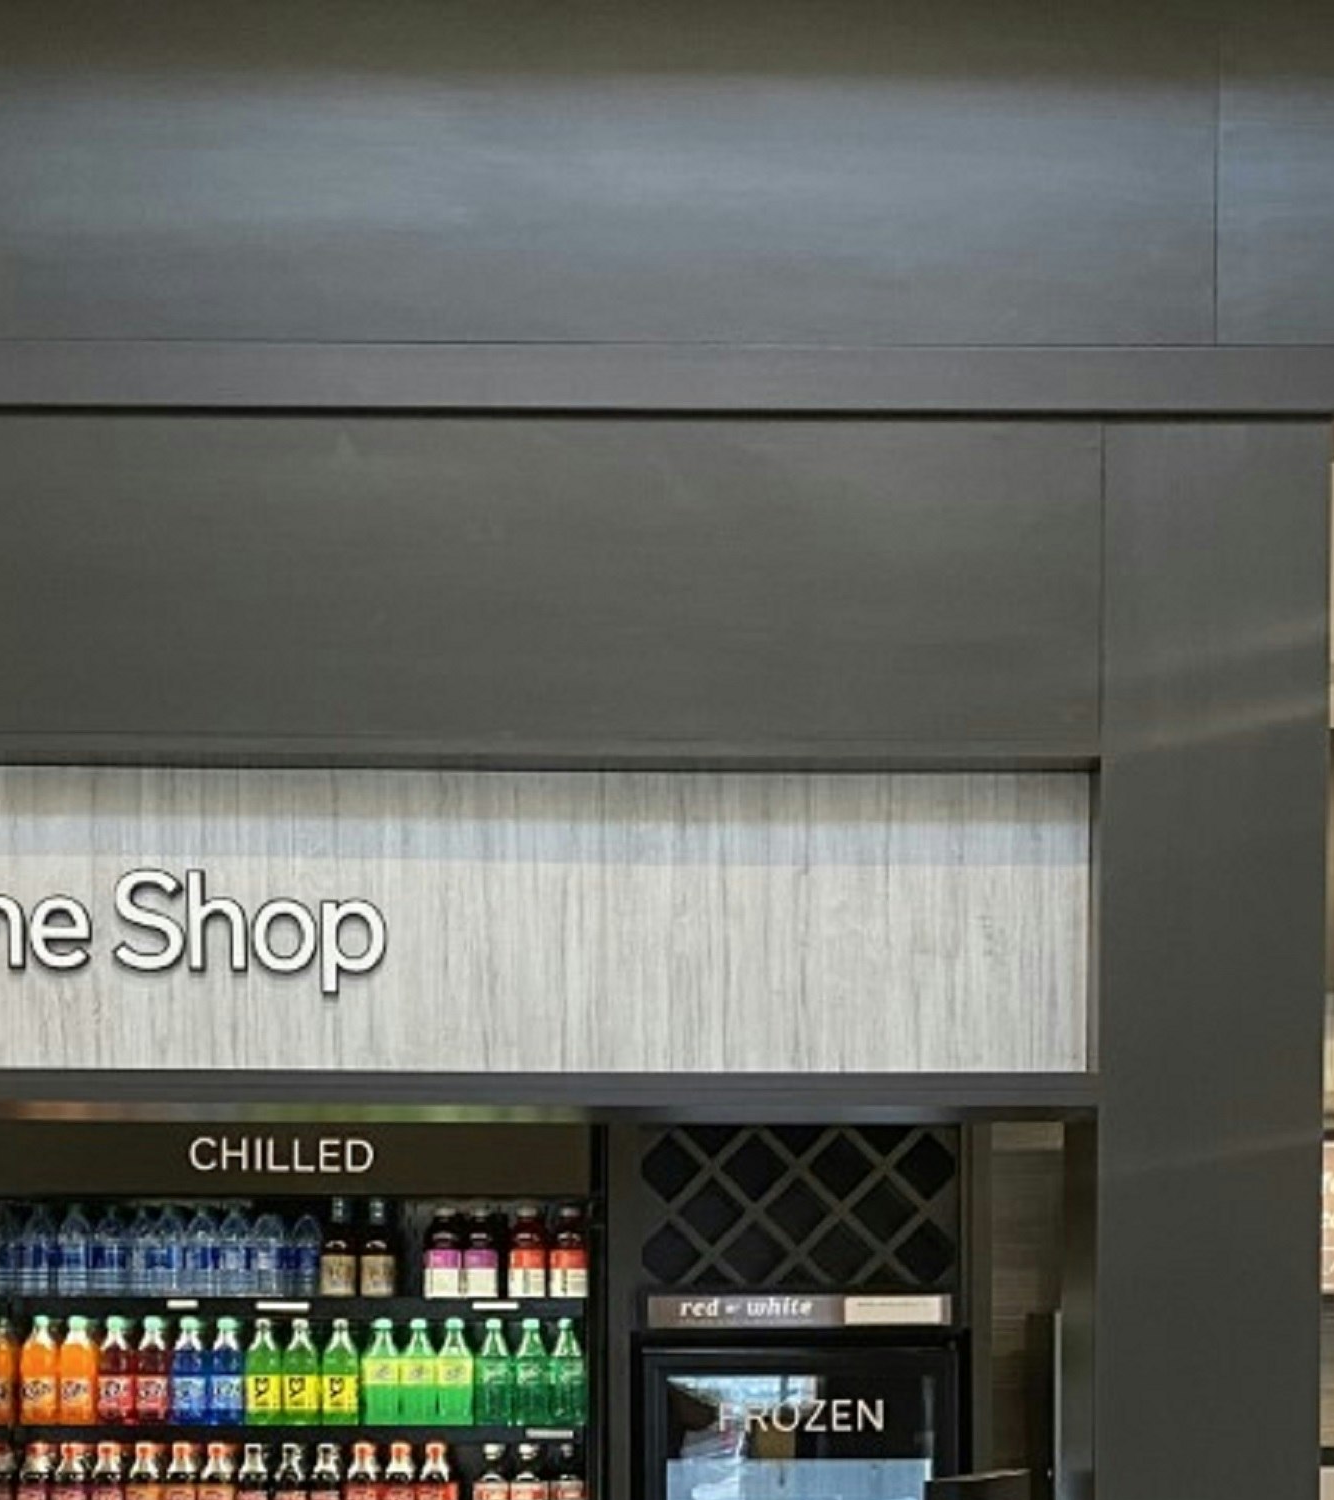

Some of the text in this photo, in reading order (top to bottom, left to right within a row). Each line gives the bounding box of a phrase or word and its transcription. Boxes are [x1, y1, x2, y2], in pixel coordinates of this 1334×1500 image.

[113, 867, 387, 995] Shop
[188, 1136, 374, 1173] CHILLED
[680, 1297, 719, 1317] red
[747, 1296, 814, 1316] white
[719, 1398, 887, 1434] FROZEN
